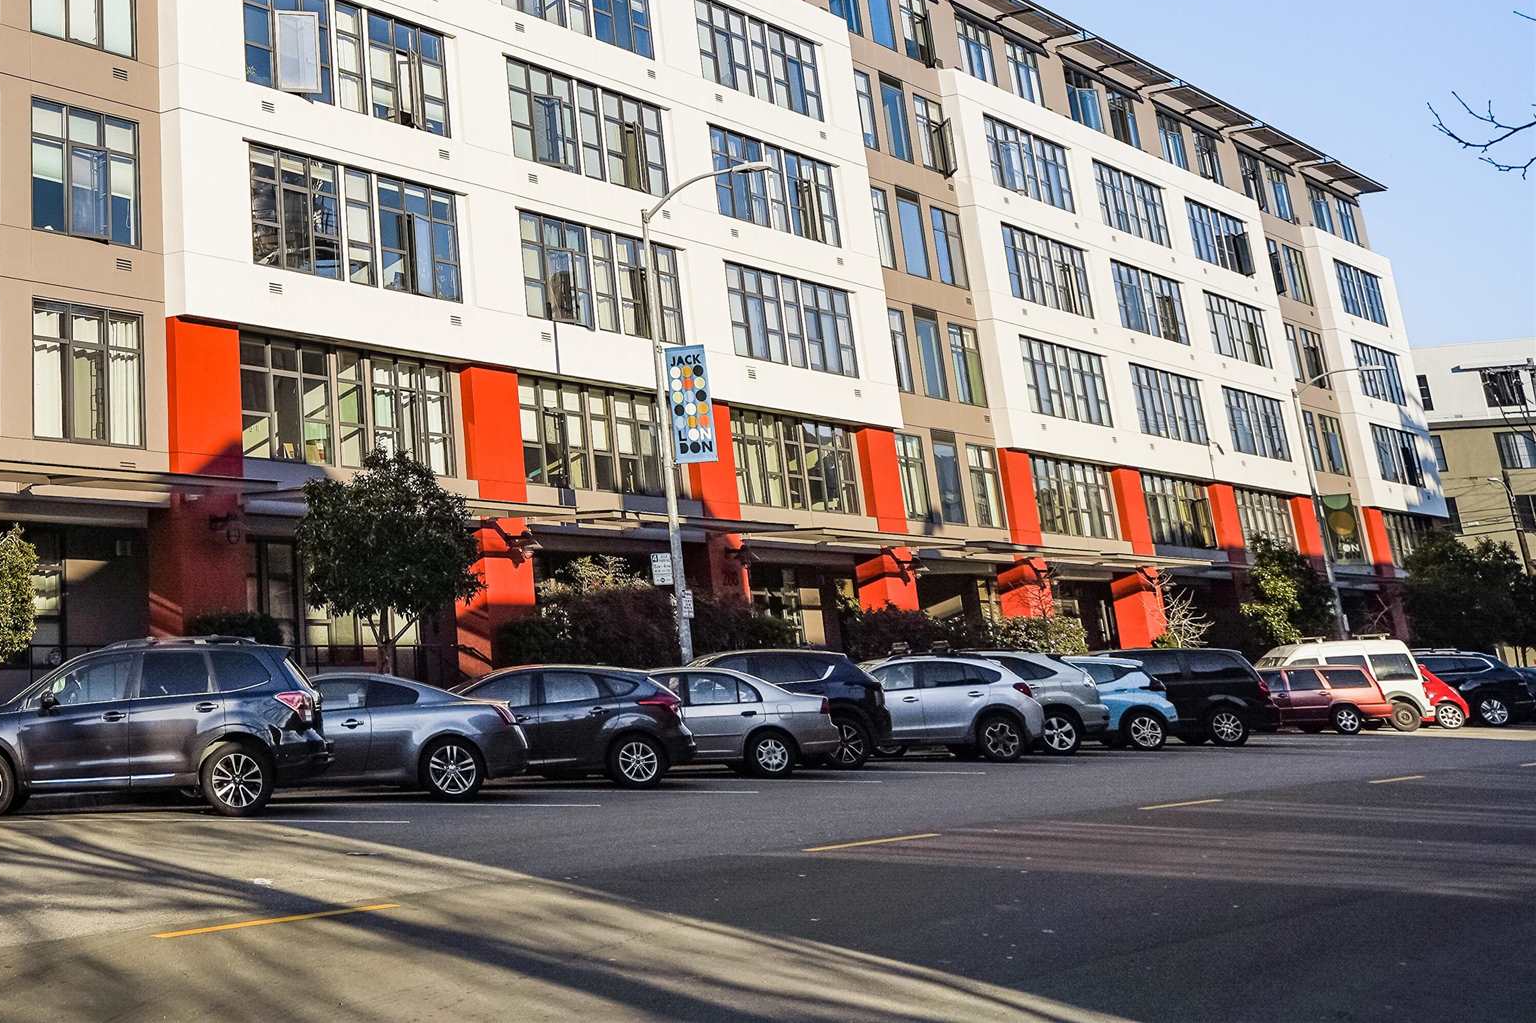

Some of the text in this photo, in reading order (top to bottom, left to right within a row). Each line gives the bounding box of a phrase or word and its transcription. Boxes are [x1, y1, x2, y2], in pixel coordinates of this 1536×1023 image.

[670, 354, 701, 367] JACK
[679, 427, 712, 441] LON
[680, 441, 713, 454] DON
